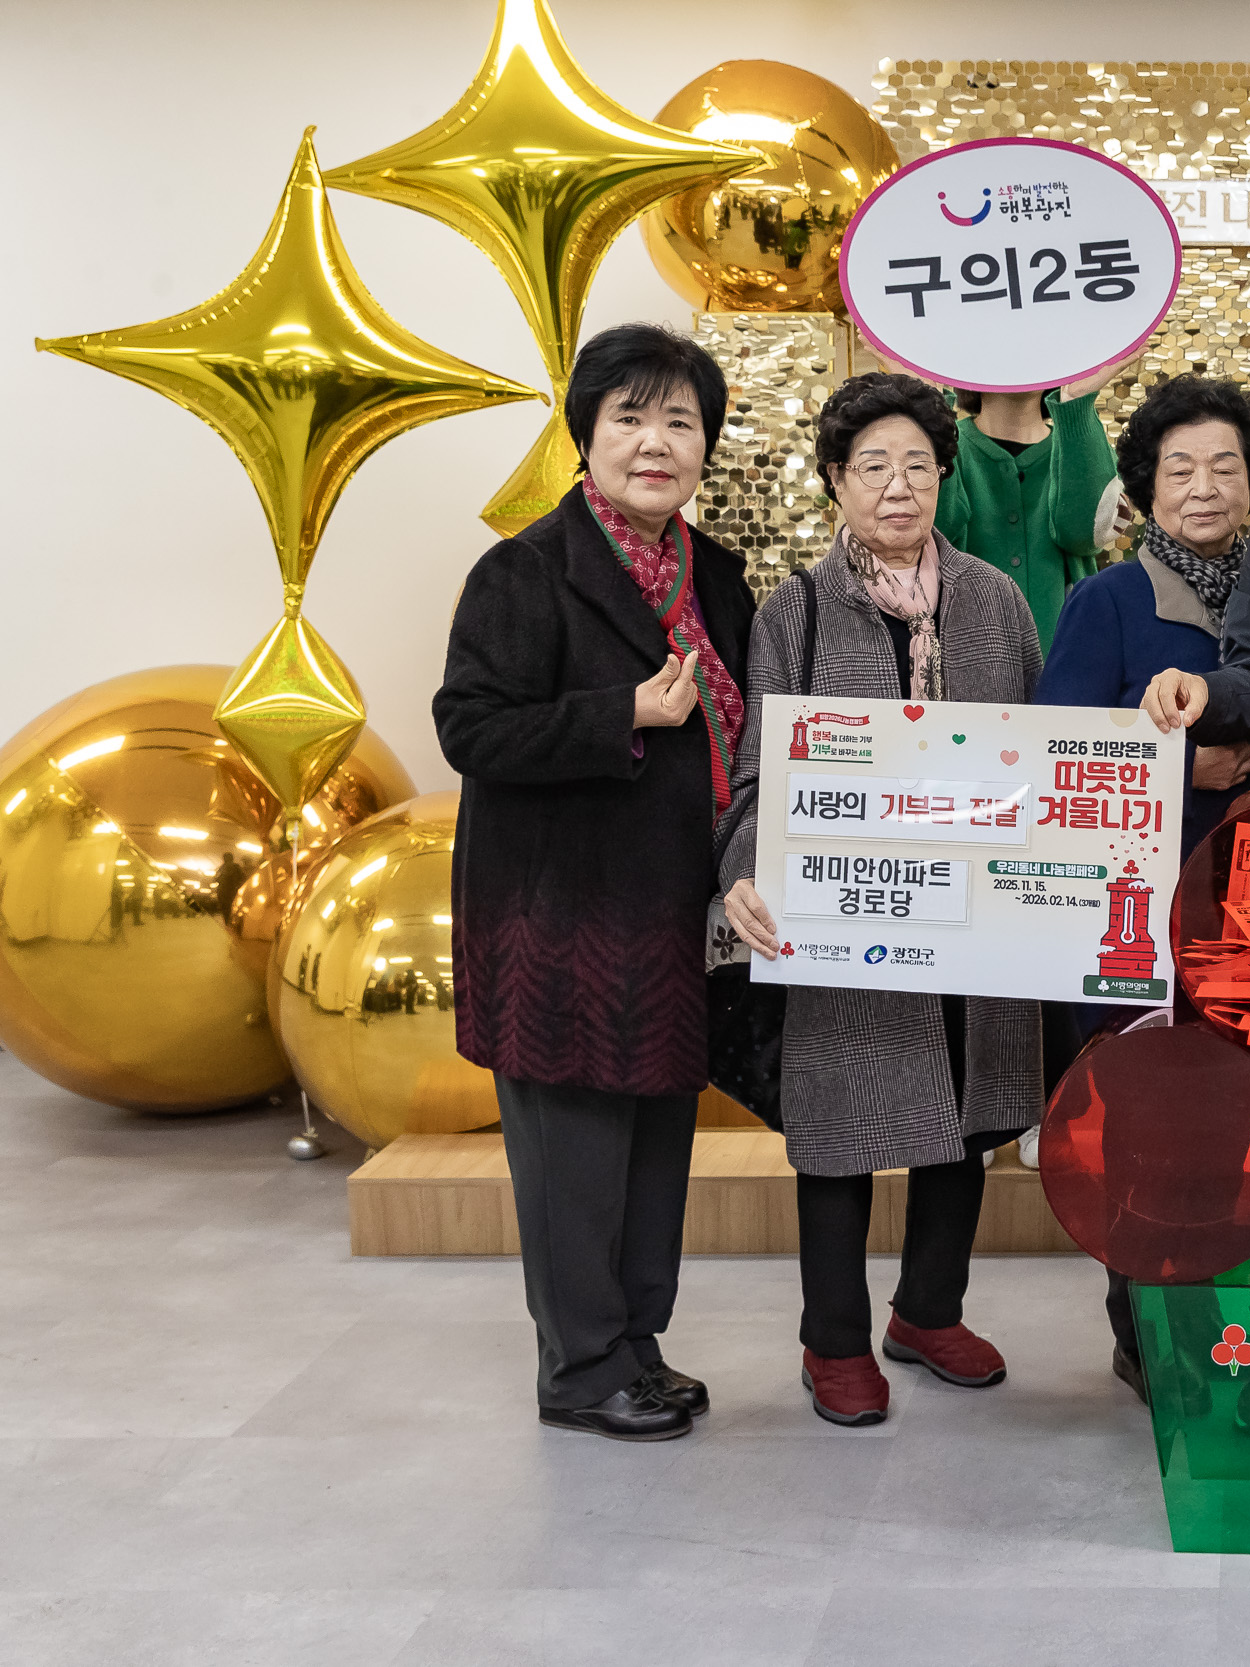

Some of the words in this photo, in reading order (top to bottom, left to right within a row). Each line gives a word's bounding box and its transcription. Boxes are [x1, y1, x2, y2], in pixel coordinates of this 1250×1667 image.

[998, 184, 1031, 200] 소통하며
[1033, 181, 1069, 198] 발전하는
[999, 196, 1072, 223] 행복광진
[1157, 189, 1207, 229] 진
[884, 239, 1140, 318] 구의2동
[812, 730, 837, 742] 행복을
[839, 734, 858, 743] 더하는
[859, 735, 873, 743] 기부
[812, 744, 837, 756] 기부로
[838, 748, 858, 756] 바꾸는
[859, 749, 872, 757] 서울
[1047, 739, 1088, 755] 2026
[1092, 740, 1158, 760] 희망온돌
[1054, 760, 1151, 796] 따뜻한
[791, 790, 867, 821] 사랑의
[968, 797, 1020, 828] 전달
[1036, 795, 1163, 833] 겨울나기
[802, 855, 951, 888] 래미안아파트
[996, 860, 1041, 875] 우리동네
[1043, 863, 1099, 878] 나눔캠페인
[993, 879, 1020, 890] 2025.
[1021, 880, 1032, 891] 11.
[1034, 880, 1047, 892] 15.
[838, 887, 913, 918] 경로당
[890, 959, 935, 967] GWANGJIN-GU
[891, 946, 935, 960] 광진구
